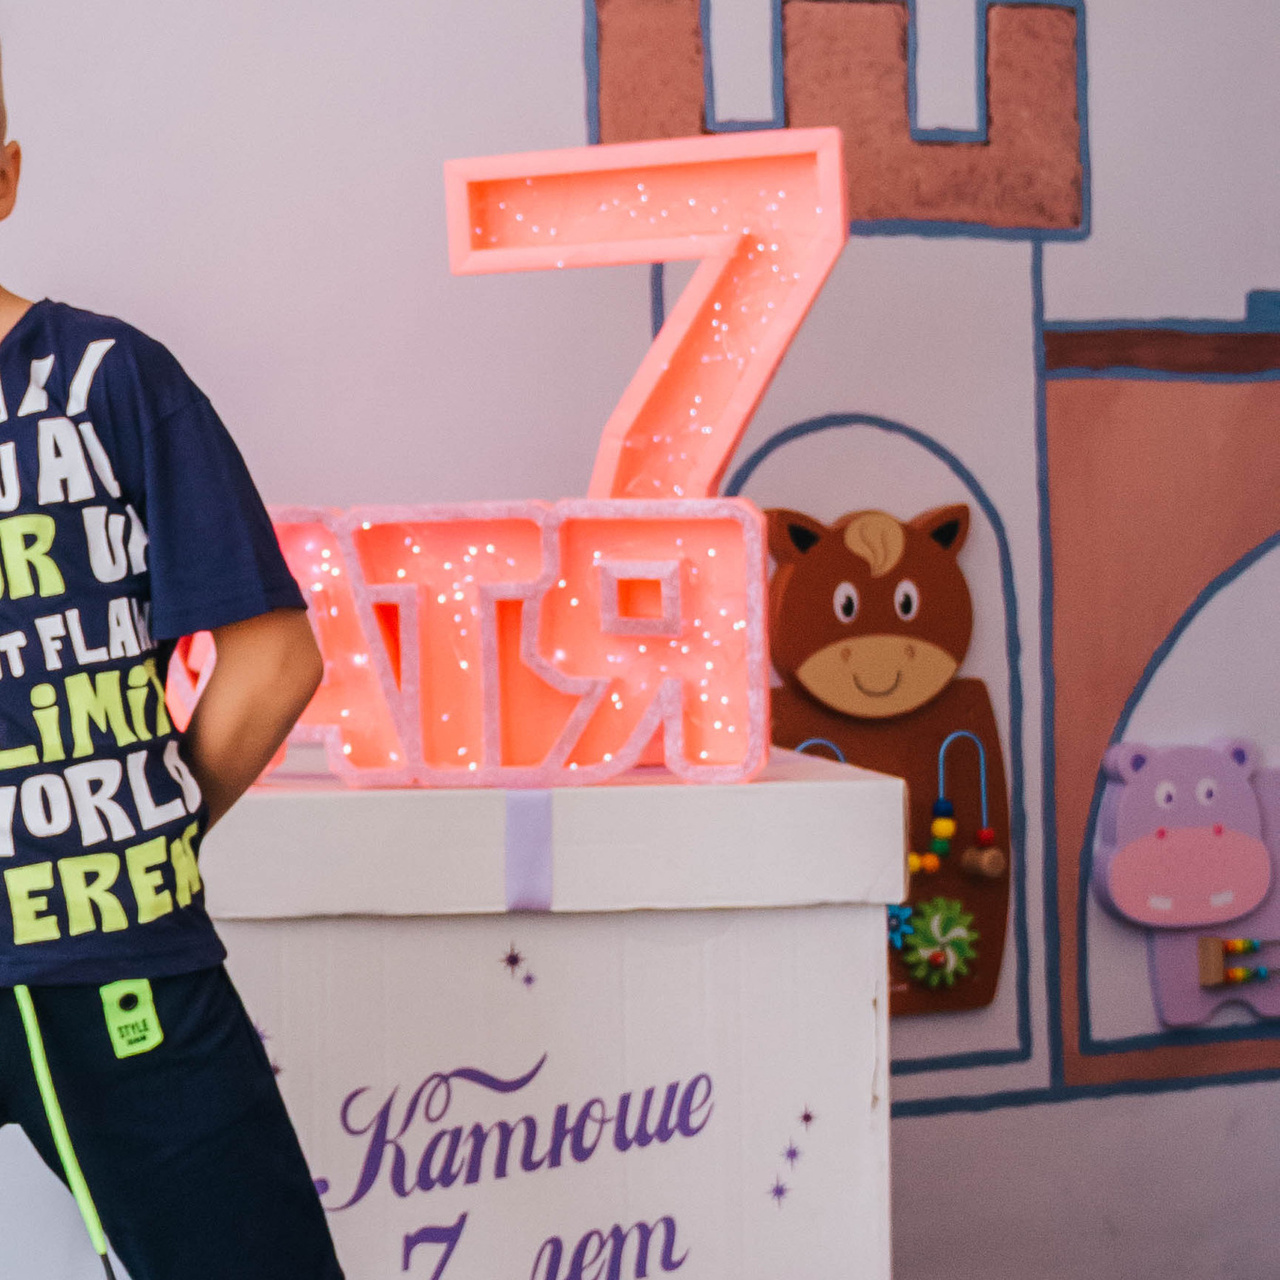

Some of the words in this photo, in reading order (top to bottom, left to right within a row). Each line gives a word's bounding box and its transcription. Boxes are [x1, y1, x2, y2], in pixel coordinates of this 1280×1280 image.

[444, 127, 850, 499] 7
[165, 497, 771, 787] АТЯ
[315, 1051, 715, 1211] Катюше
